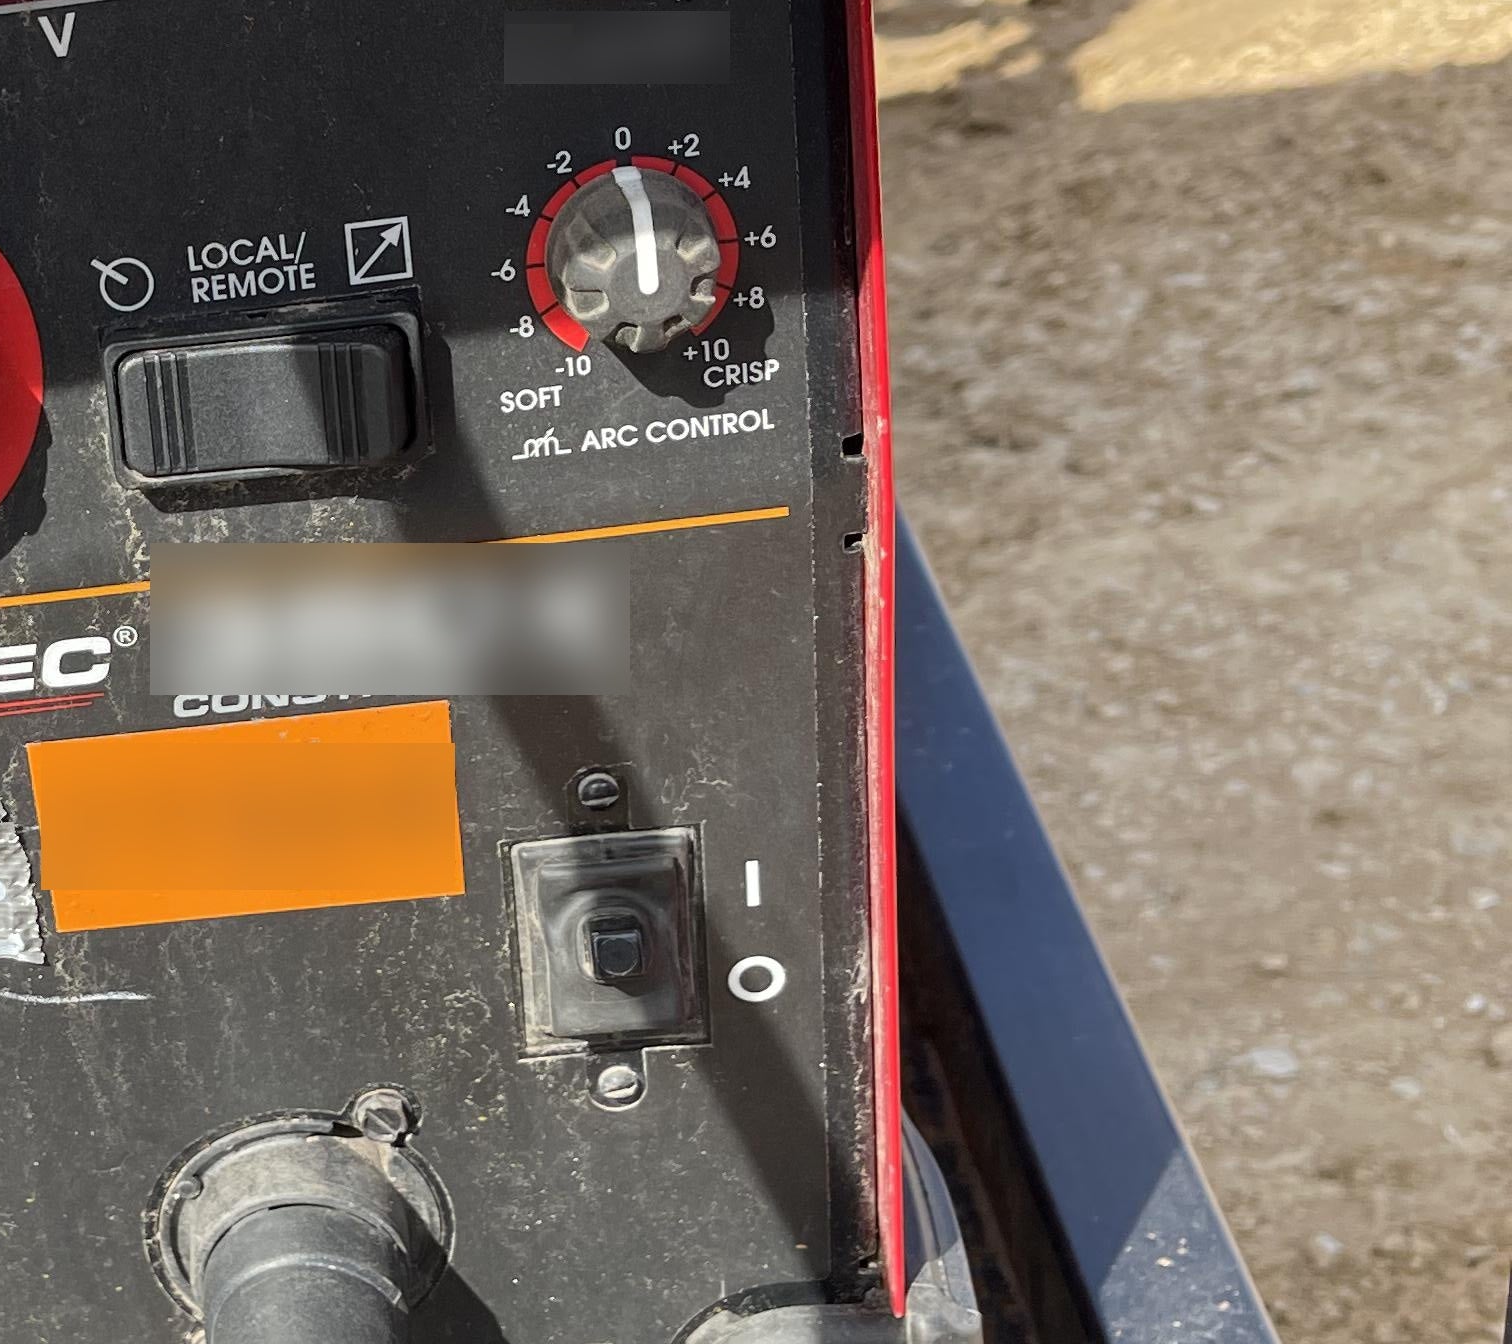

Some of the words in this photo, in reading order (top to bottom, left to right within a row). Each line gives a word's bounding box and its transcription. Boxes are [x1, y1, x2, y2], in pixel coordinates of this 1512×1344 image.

[37, 11, 76, 58] V
[614, 126, 631, 151] 0
[668, 133, 700, 158] +2
[546, 150, 573, 175] -2
[718, 165, 751, 190] +4
[505, 194, 531, 217] -4
[743, 224, 777, 249] +6
[187, 231, 307, 272] LOCAL/
[490, 258, 517, 282] -6
[190, 262, 316, 304] REMOTE
[733, 286, 765, 310] +8
[509, 315, 535, 338] -8
[683, 338, 730, 362] +10
[554, 355, 592, 378] -10
[702, 358, 780, 389] CRISP
[499, 385, 563, 414] SOFT
[581, 424, 638, 453] ARC
[644, 408, 775, 444] CONTROL
